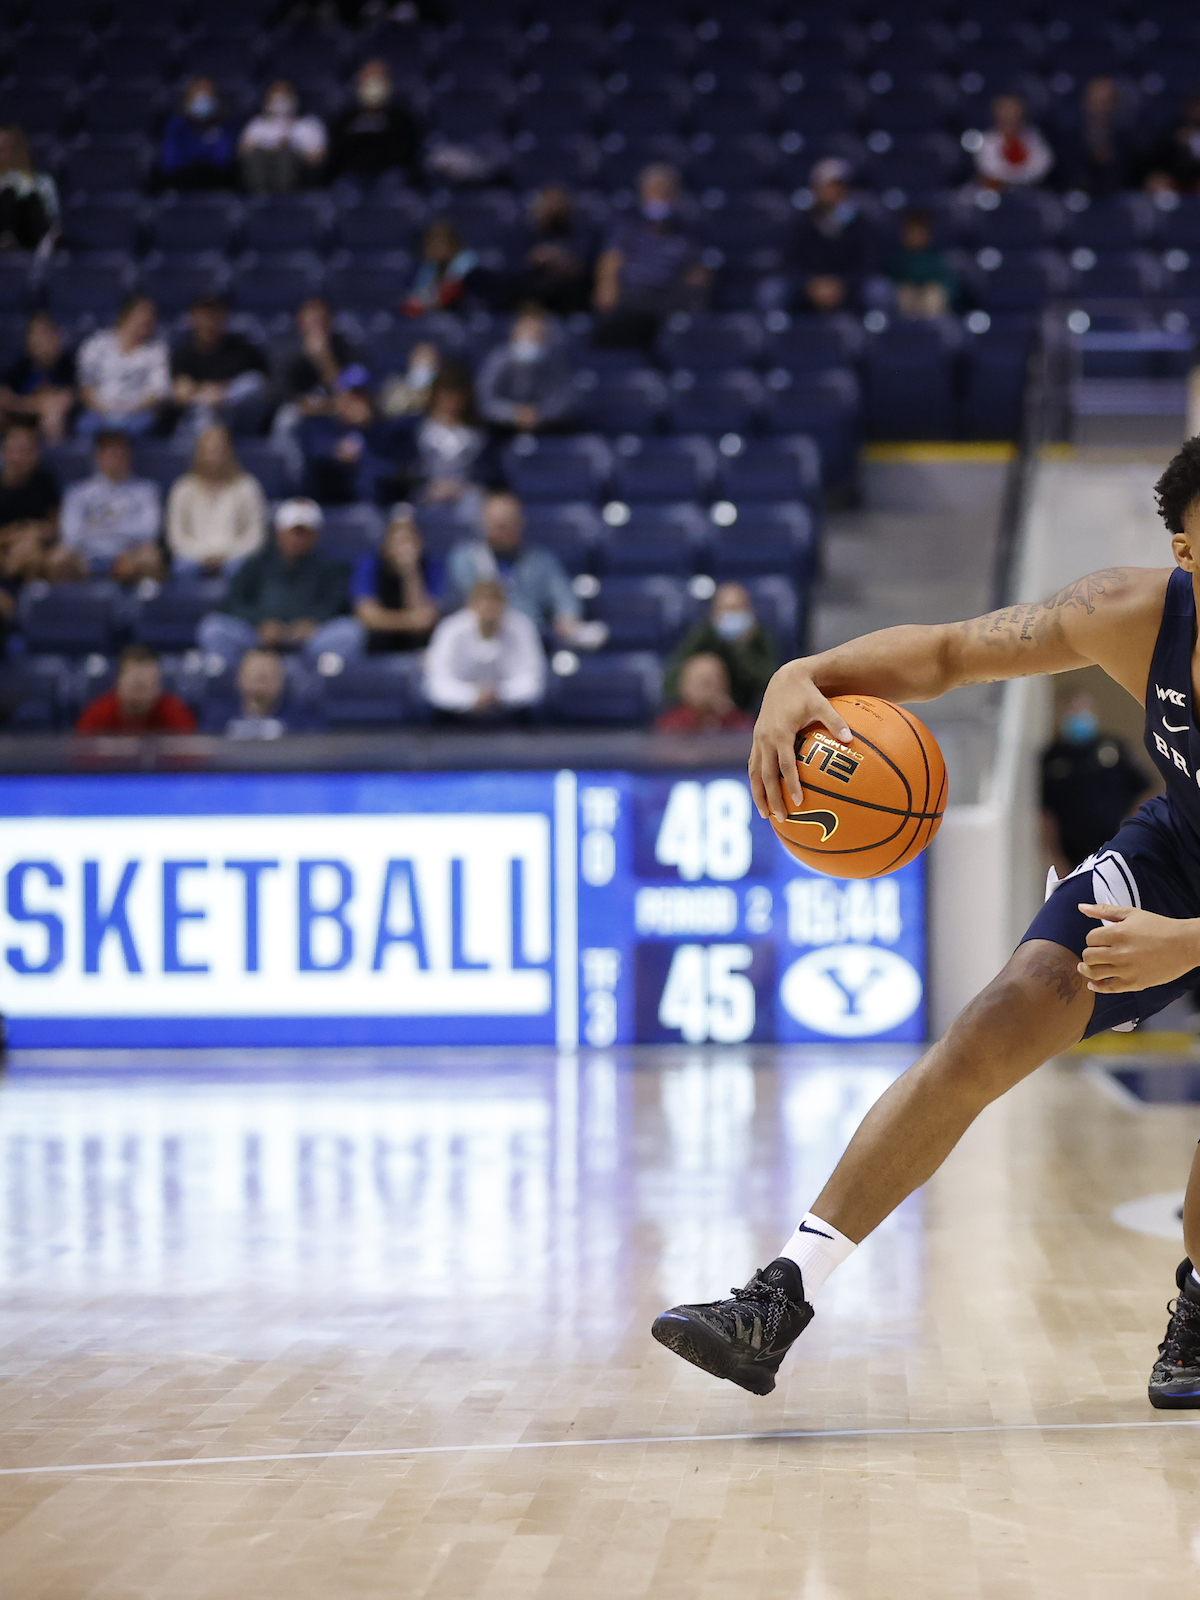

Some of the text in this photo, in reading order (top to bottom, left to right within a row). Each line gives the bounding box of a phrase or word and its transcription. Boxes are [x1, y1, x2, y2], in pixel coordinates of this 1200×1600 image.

[656, 779, 752, 881] 48
[4, 859, 553, 974] SKETBALL
[658, 944, 756, 1043] 45
